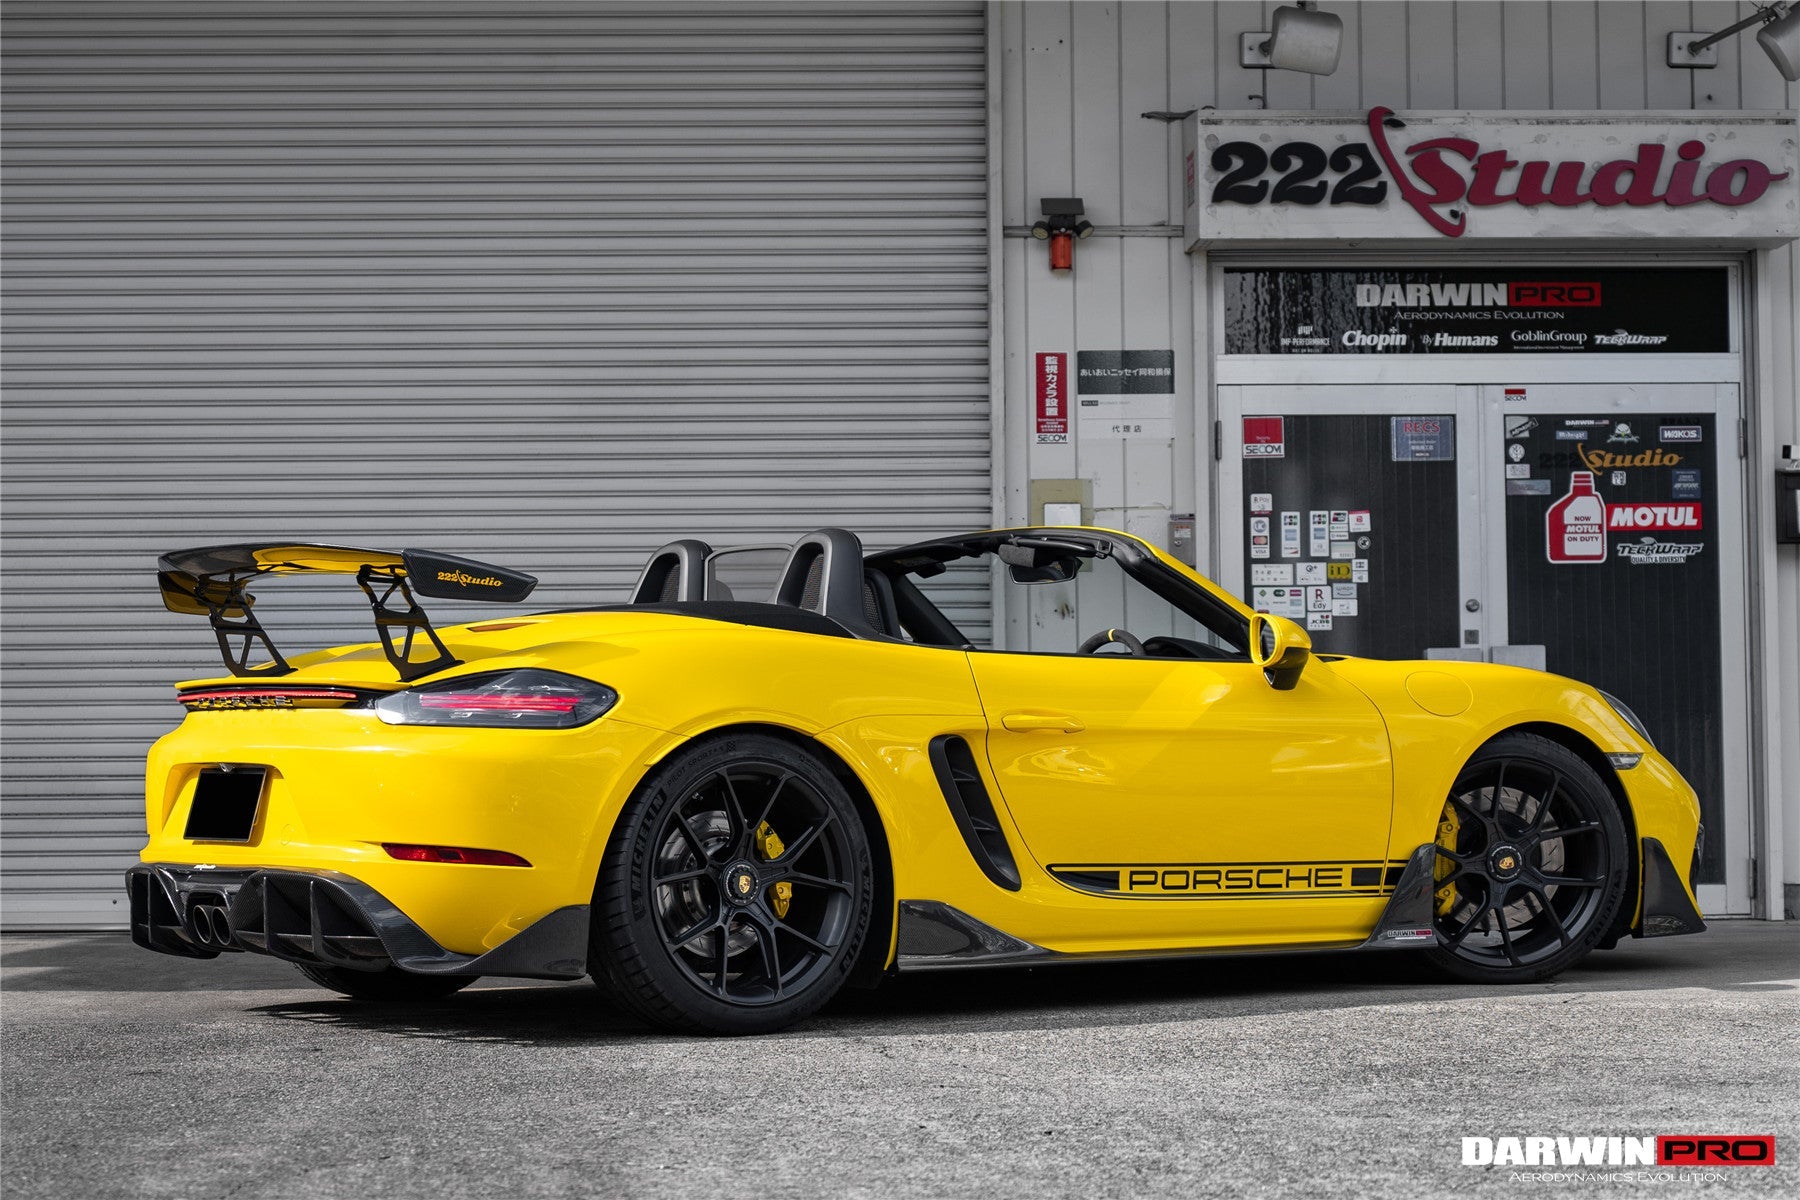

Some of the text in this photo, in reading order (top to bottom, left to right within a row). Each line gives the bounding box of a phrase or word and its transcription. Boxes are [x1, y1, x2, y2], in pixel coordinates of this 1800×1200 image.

[1211, 141, 1388, 206] 222
[1368, 106, 1789, 237] Studio
[1356, 283, 1596, 307] DARWIN PRO
[1342, 326, 1407, 351] Chopin
[1434, 332, 1499, 347] Humans
[1511, 329, 1588, 344] GoblinGroup
[1403, 421, 1441, 433] RECS
[1037, 434, 1067, 442] SECOM
[1245, 444, 1282, 454] SECOM
[1577, 443, 1684, 476] Studio
[1610, 506, 1698, 527] MOTUL
[1566, 525, 1600, 533] MOTUL
[1631, 556, 1653, 564] QUALITY
[437, 569, 503, 587] 222 Studio
[631, 792, 664, 893] MICHELIN
[1129, 867, 1343, 890] PORSCHE
